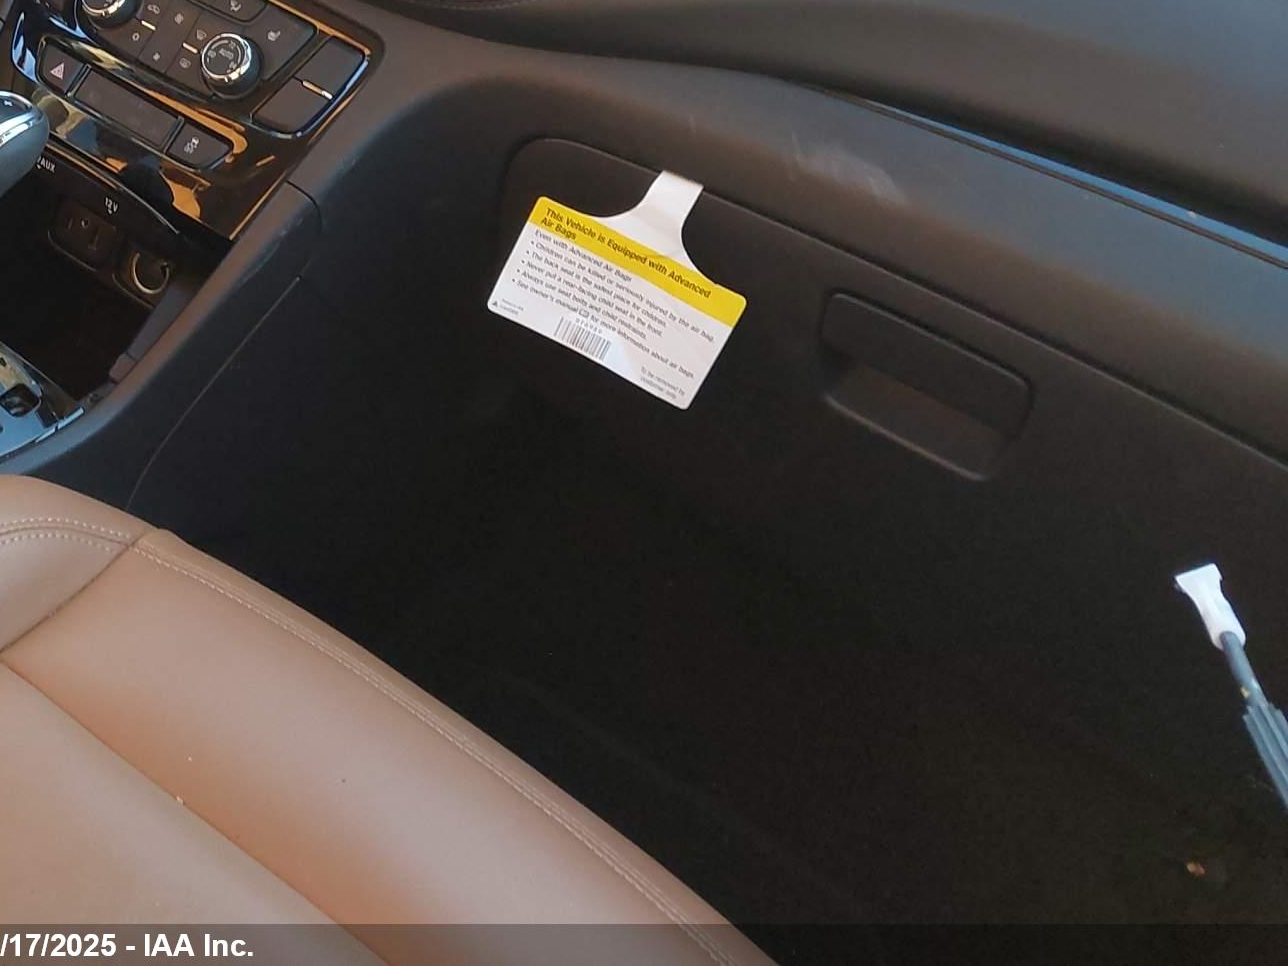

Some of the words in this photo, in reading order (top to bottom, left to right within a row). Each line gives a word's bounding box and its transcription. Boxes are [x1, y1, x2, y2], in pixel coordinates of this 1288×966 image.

[40, 158, 55, 173] AUX
[541, 218, 554, 227] Air
[555, 224, 576, 240] Bags
[566, 218, 596, 238] Vehicle
[598, 234, 605, 243] is
[607, 239, 647, 264] Equipped
[649, 260, 667, 274] with
[668, 271, 711, 298] Advanced
